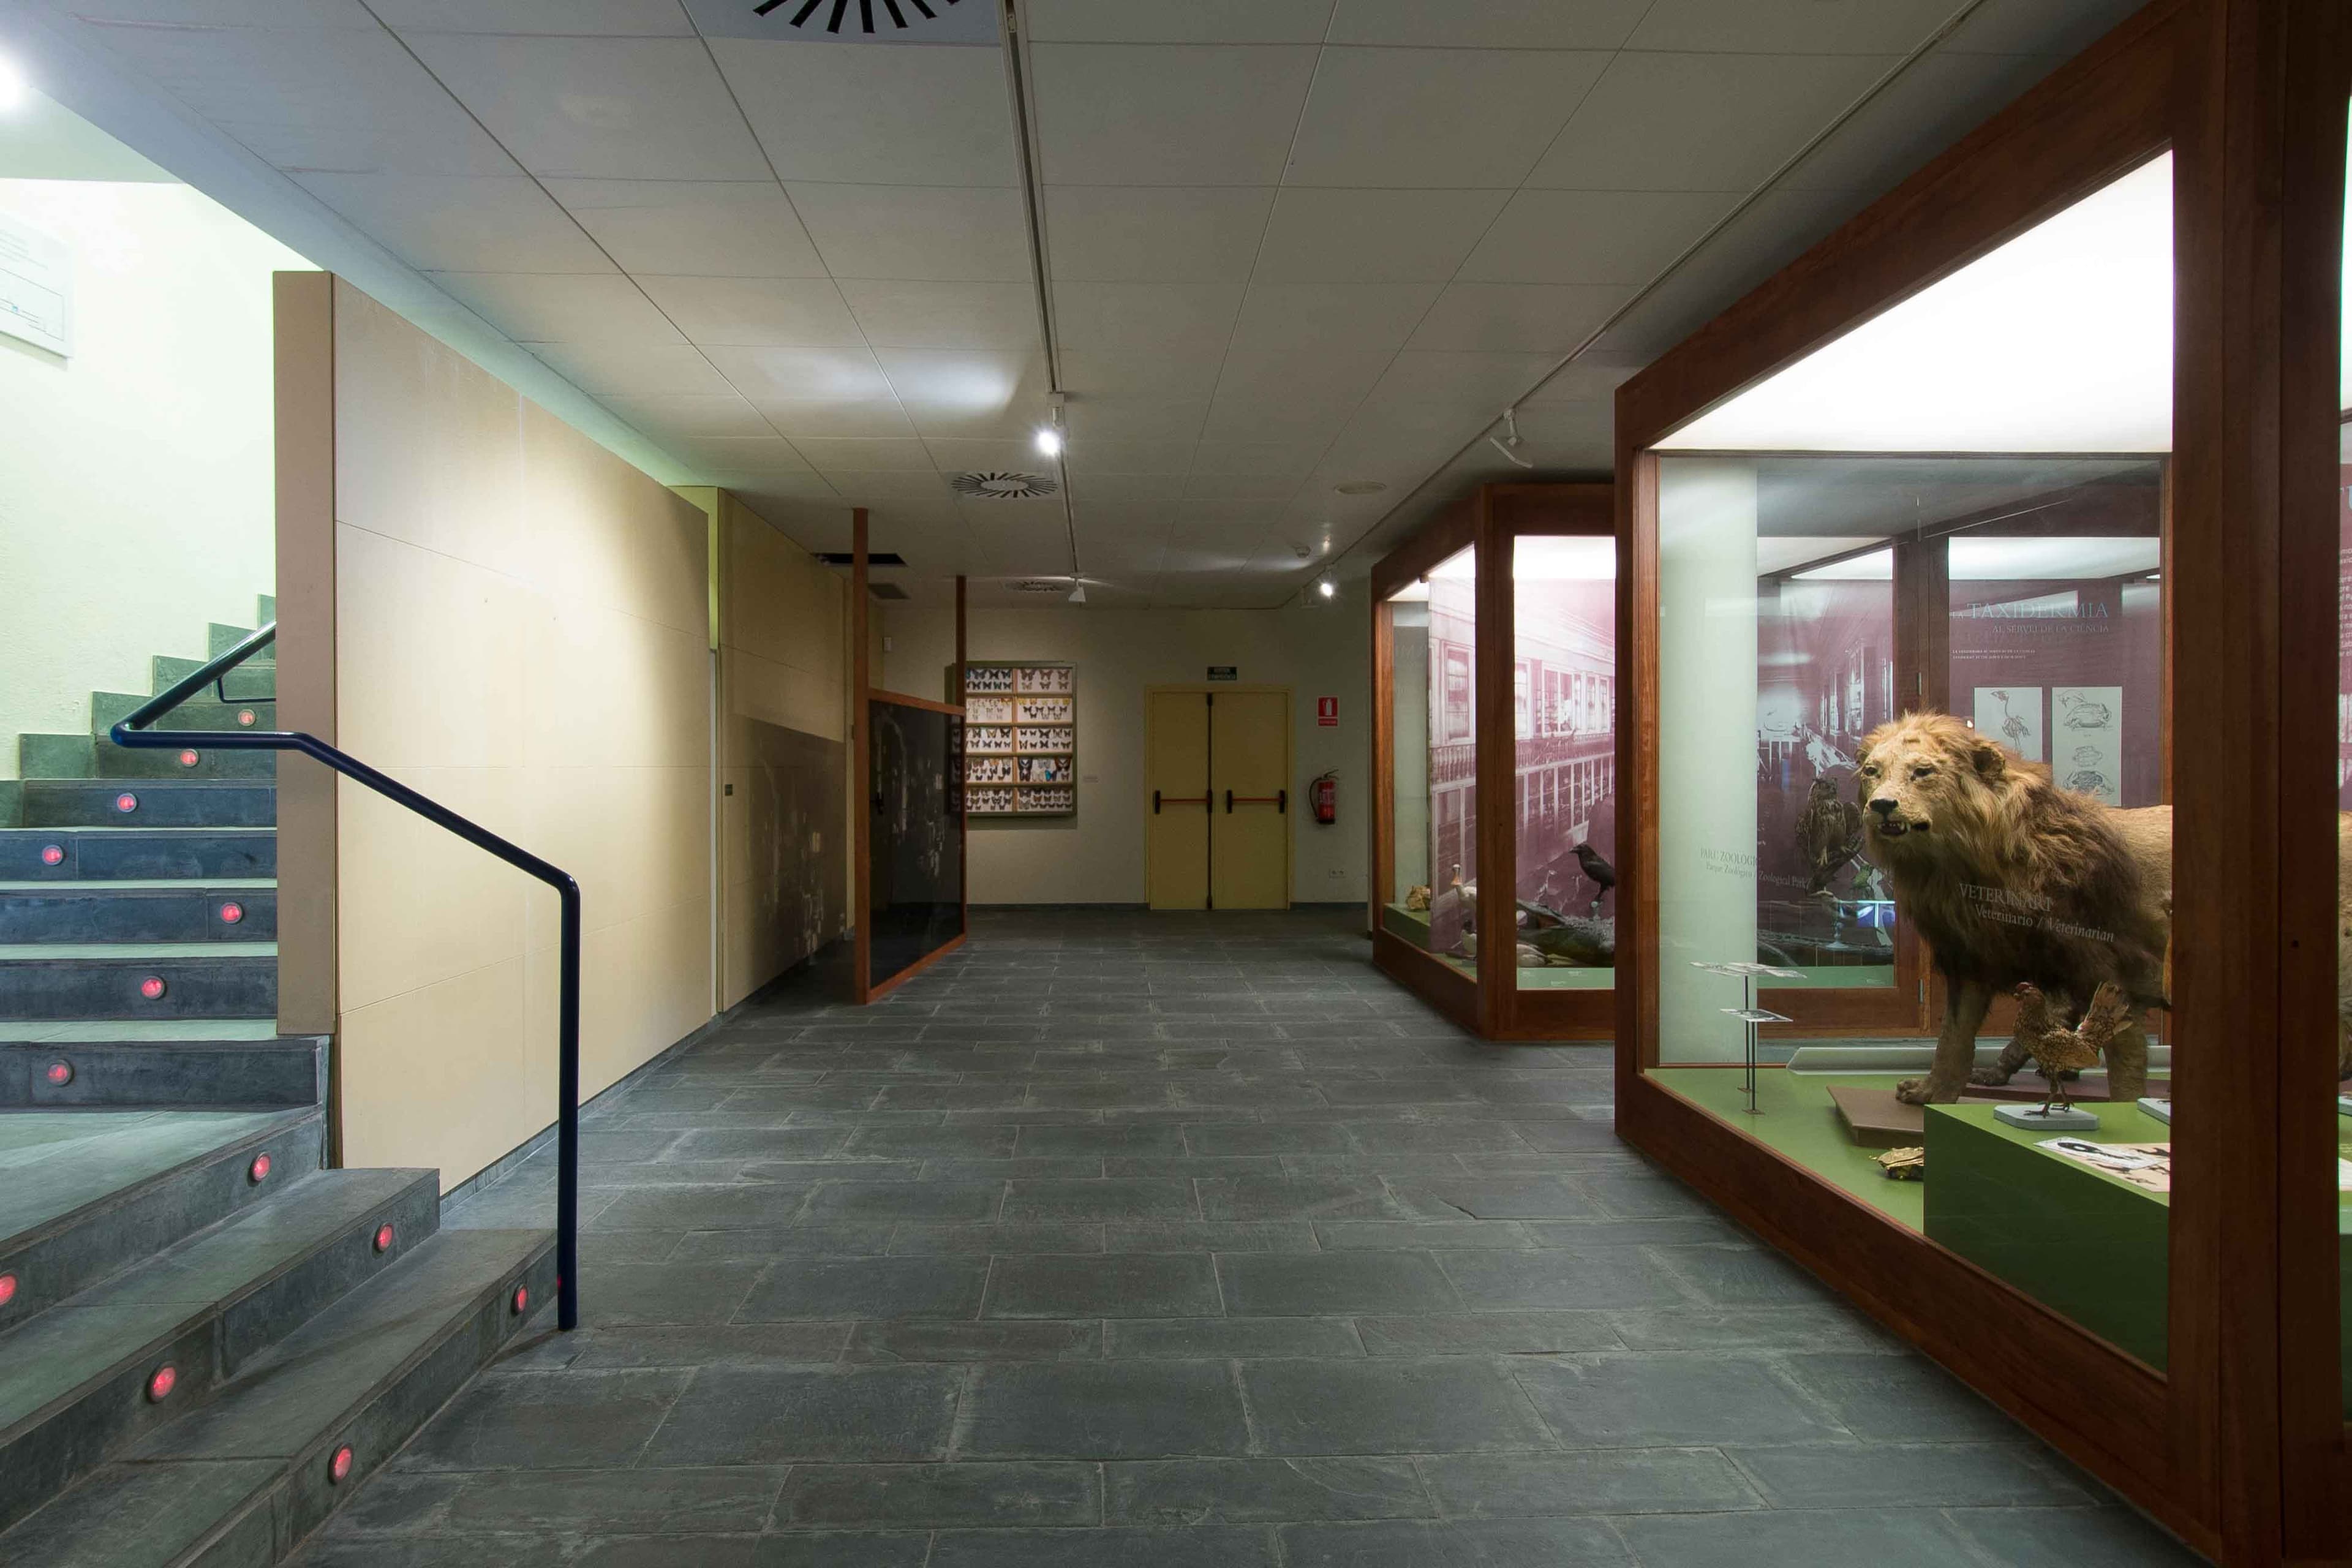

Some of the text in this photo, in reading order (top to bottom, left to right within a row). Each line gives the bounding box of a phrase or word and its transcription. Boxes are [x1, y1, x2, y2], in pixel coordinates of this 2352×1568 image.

[1967, 602, 2109, 619] TAXIDERMIA
[1960, 883, 2052, 912] VETERINARI
[1975, 903, 2034, 927] Veterinario
[2048, 918, 2114, 943] Veterinarian
